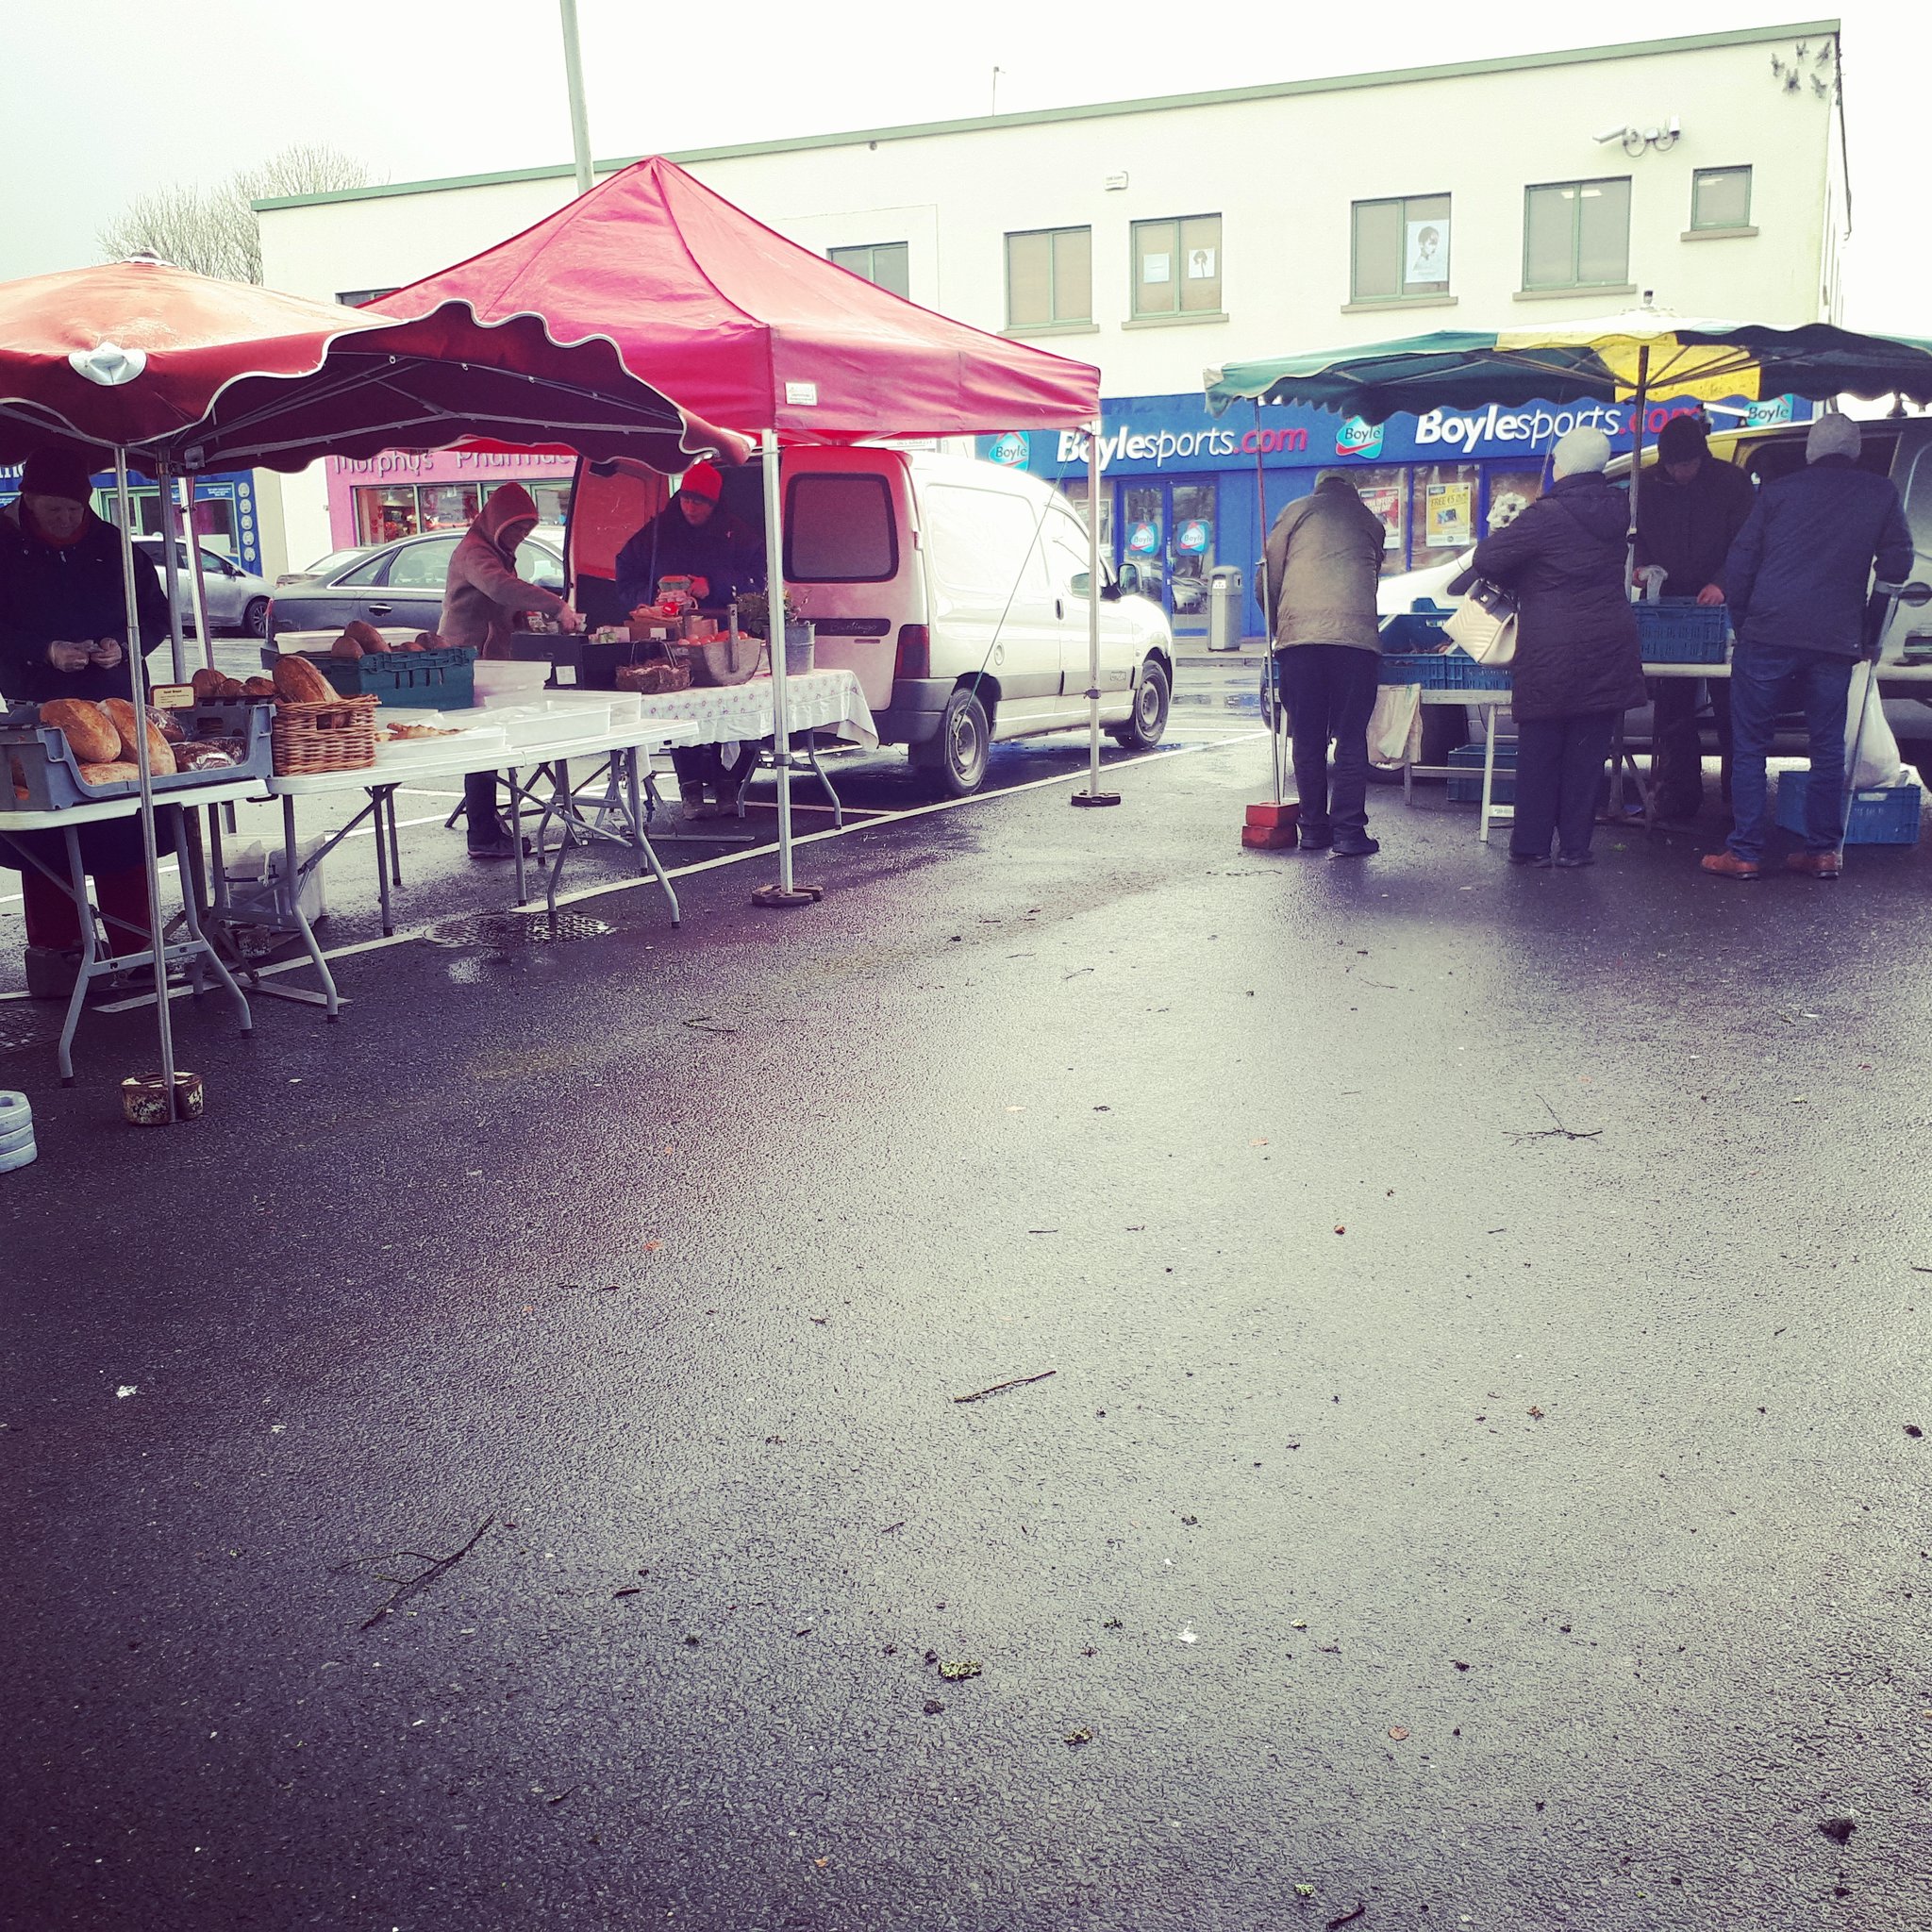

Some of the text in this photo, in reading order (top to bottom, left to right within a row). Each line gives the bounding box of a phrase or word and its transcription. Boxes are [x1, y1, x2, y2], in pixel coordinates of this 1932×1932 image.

[1748, 404, 1790, 422] Boyle
[1344, 425, 1381, 441] Boyle
[1415, 403, 1700, 453] Boylesports.co
[995, 444, 1027, 460] Boyle
[1134, 536, 1153, 545] Boyle
[1184, 535, 1204, 544] Boyle
